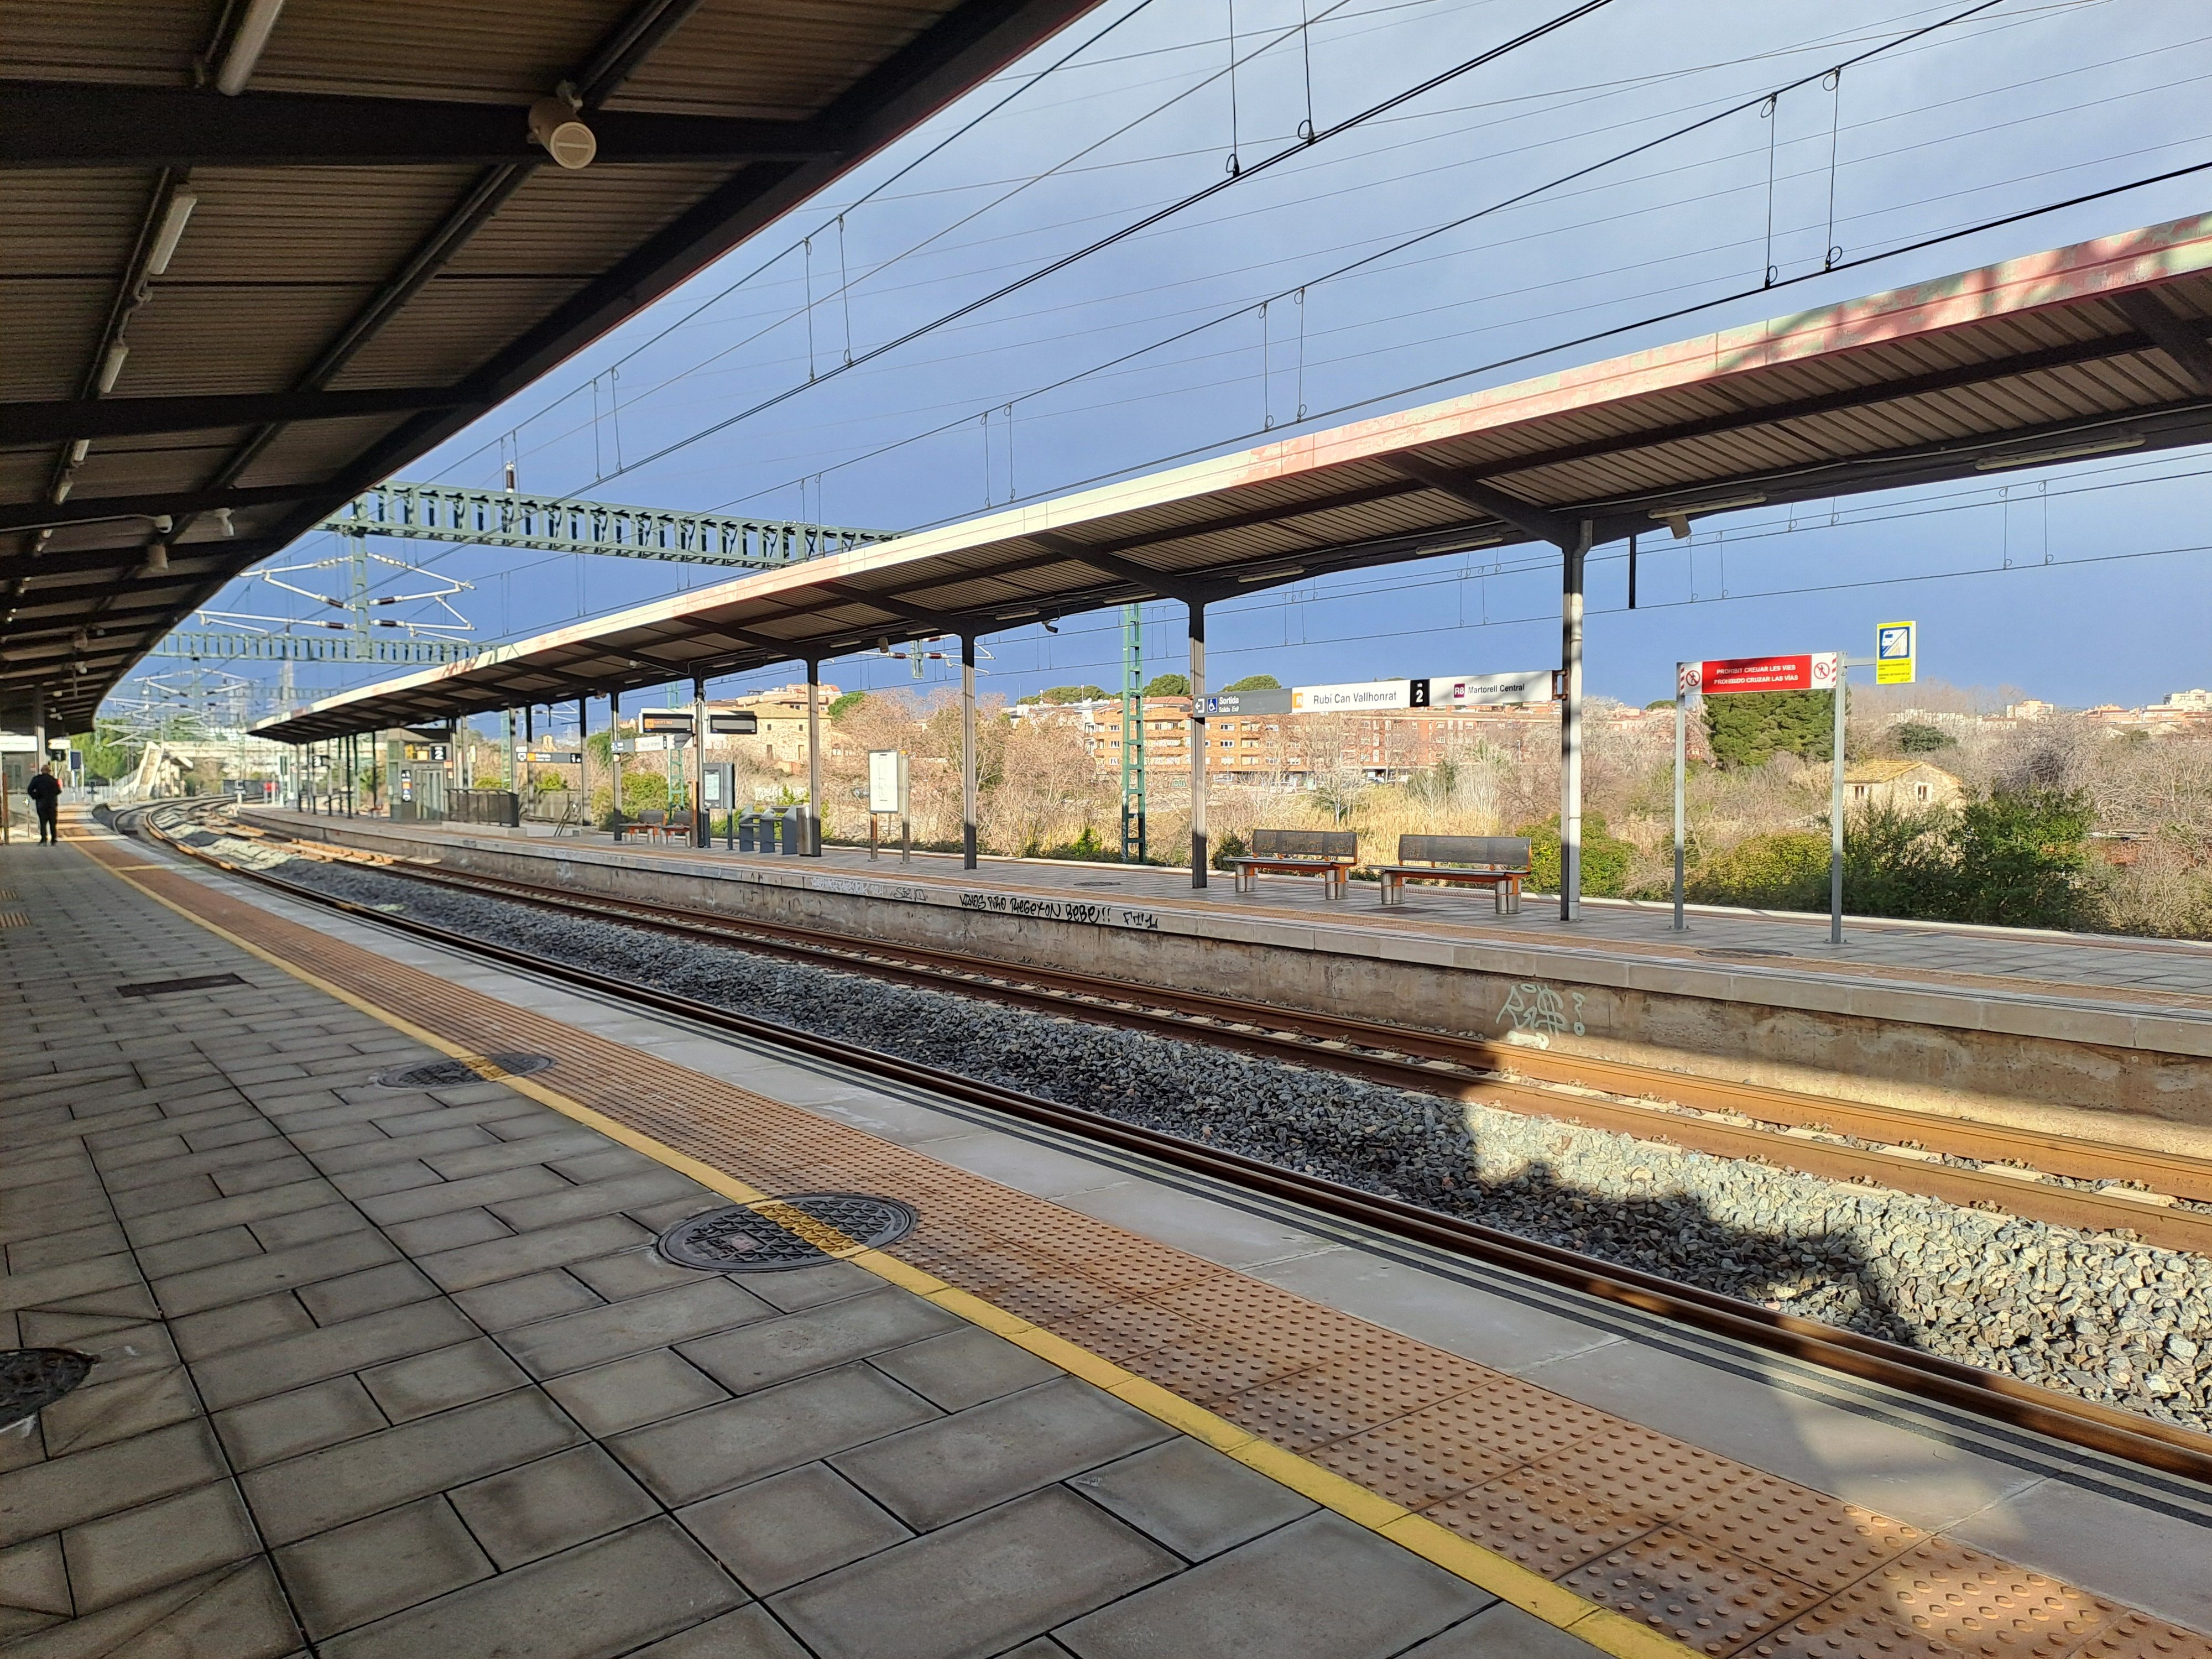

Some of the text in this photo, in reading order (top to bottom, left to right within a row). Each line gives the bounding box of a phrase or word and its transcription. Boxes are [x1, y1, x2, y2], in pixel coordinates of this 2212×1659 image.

[1454, 684, 1525, 695] R8 Martorell Central
[1219, 695, 1239, 705] Sortida
[1313, 693, 1332, 705] Rubí
[1334, 693, 1350, 703] Can
[1353, 691, 1396, 702] Vallhonrat
[1416, 690, 1423, 702] 2
[435, 750, 444, 760] 2
